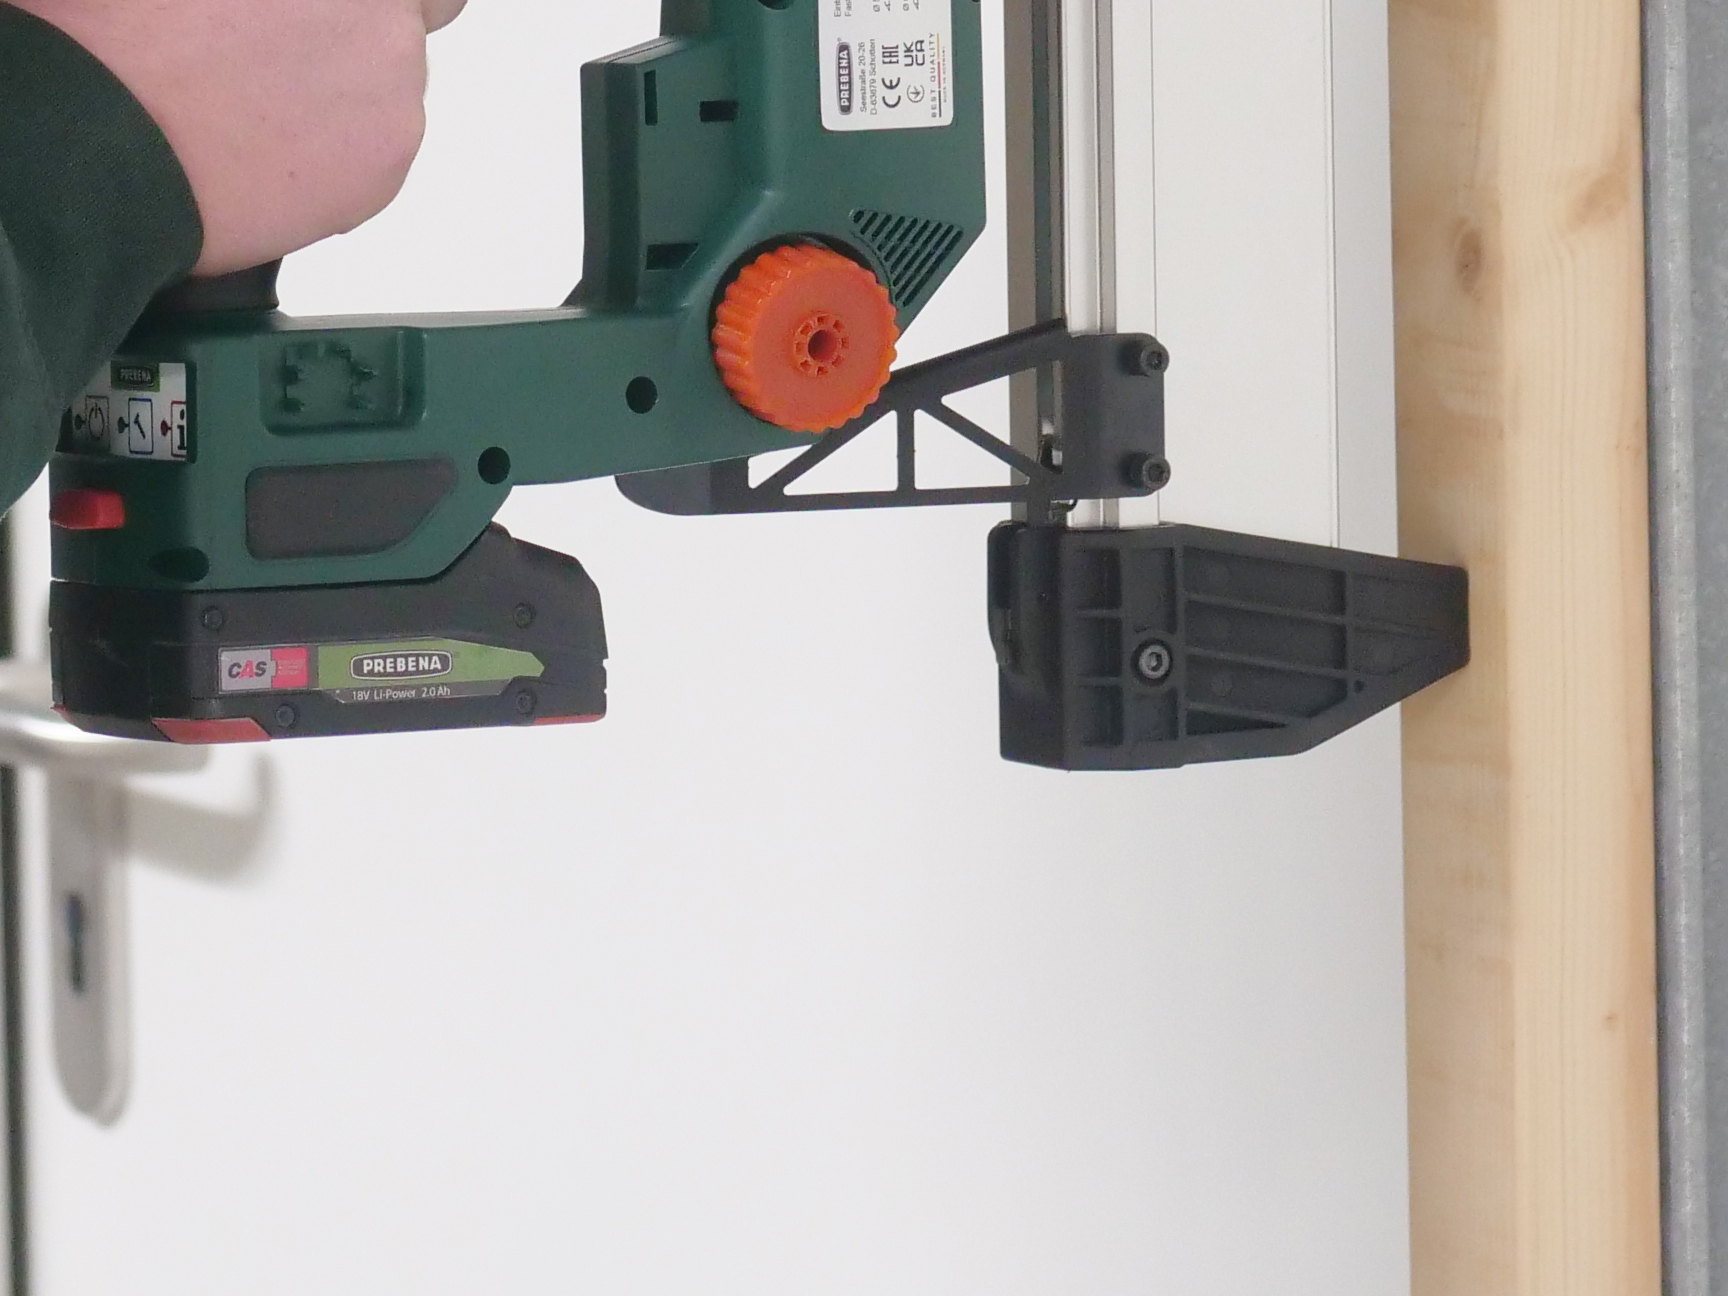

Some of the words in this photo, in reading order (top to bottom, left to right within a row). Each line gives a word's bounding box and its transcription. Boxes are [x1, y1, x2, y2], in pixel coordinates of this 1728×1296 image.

[858, 42, 866, 66] 20-26
[868, 38, 876, 76] Schotten
[839, 50, 850, 106] PREBENA
[859, 69, 867, 112] Seestraße
[881, 77, 901, 108] CE
[227, 659, 268, 680] CAS
[362, 654, 442, 674] PREBENA
[352, 690, 370, 701] 18V
[373, 688, 416, 700] Li-Power
[422, 687, 436, 697] 2.0
[437, 686, 451, 696] Ah
